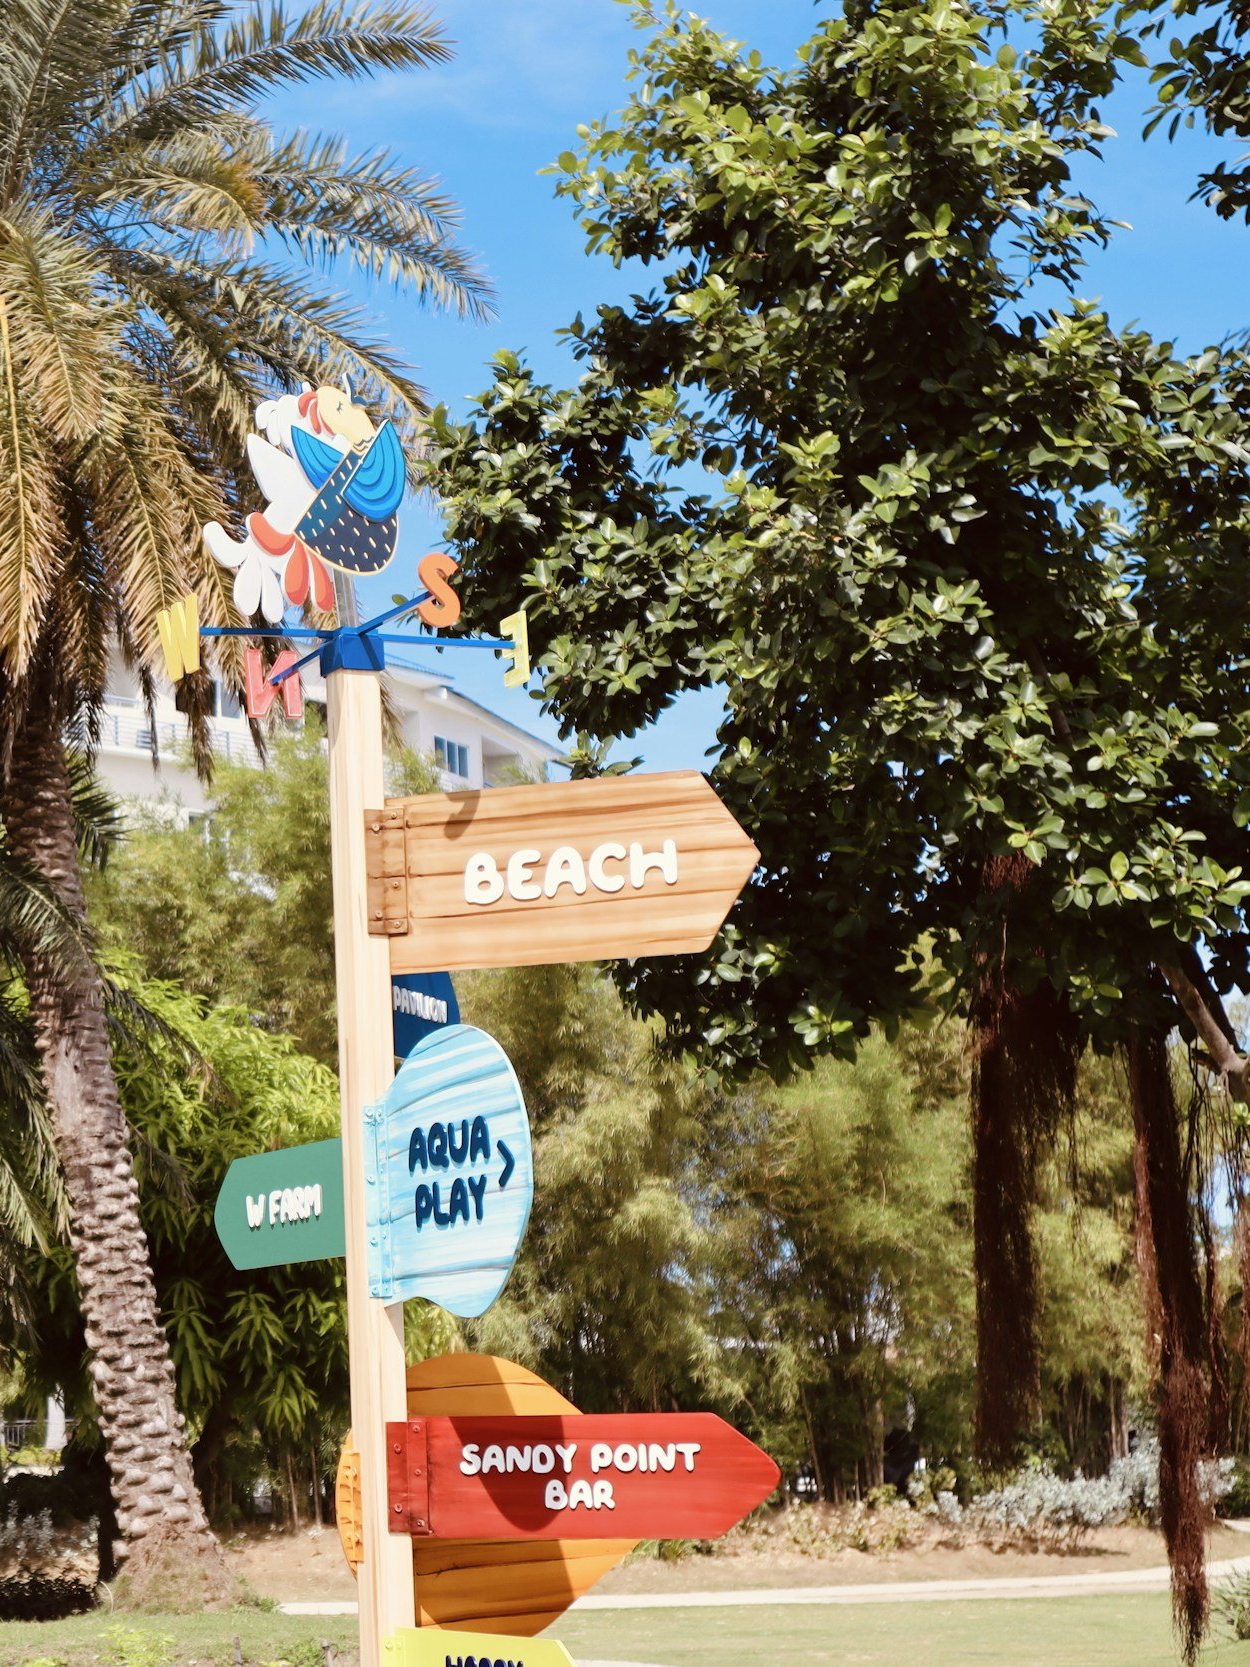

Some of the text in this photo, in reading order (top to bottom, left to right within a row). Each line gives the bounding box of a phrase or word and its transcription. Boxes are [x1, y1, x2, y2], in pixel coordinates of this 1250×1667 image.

[418, 552, 461, 627] S
[156, 593, 200, 682] W
[463, 839, 679, 906] BEACH
[392, 985, 447, 1023] PAVILION
[408, 1115, 491, 1172] AQUA
[246, 1183, 322, 1229] W FARM
[415, 1174, 487, 1229] PLAY
[459, 1442, 702, 1476] SANDY POINT
[544, 1479, 616, 1511] BAR
